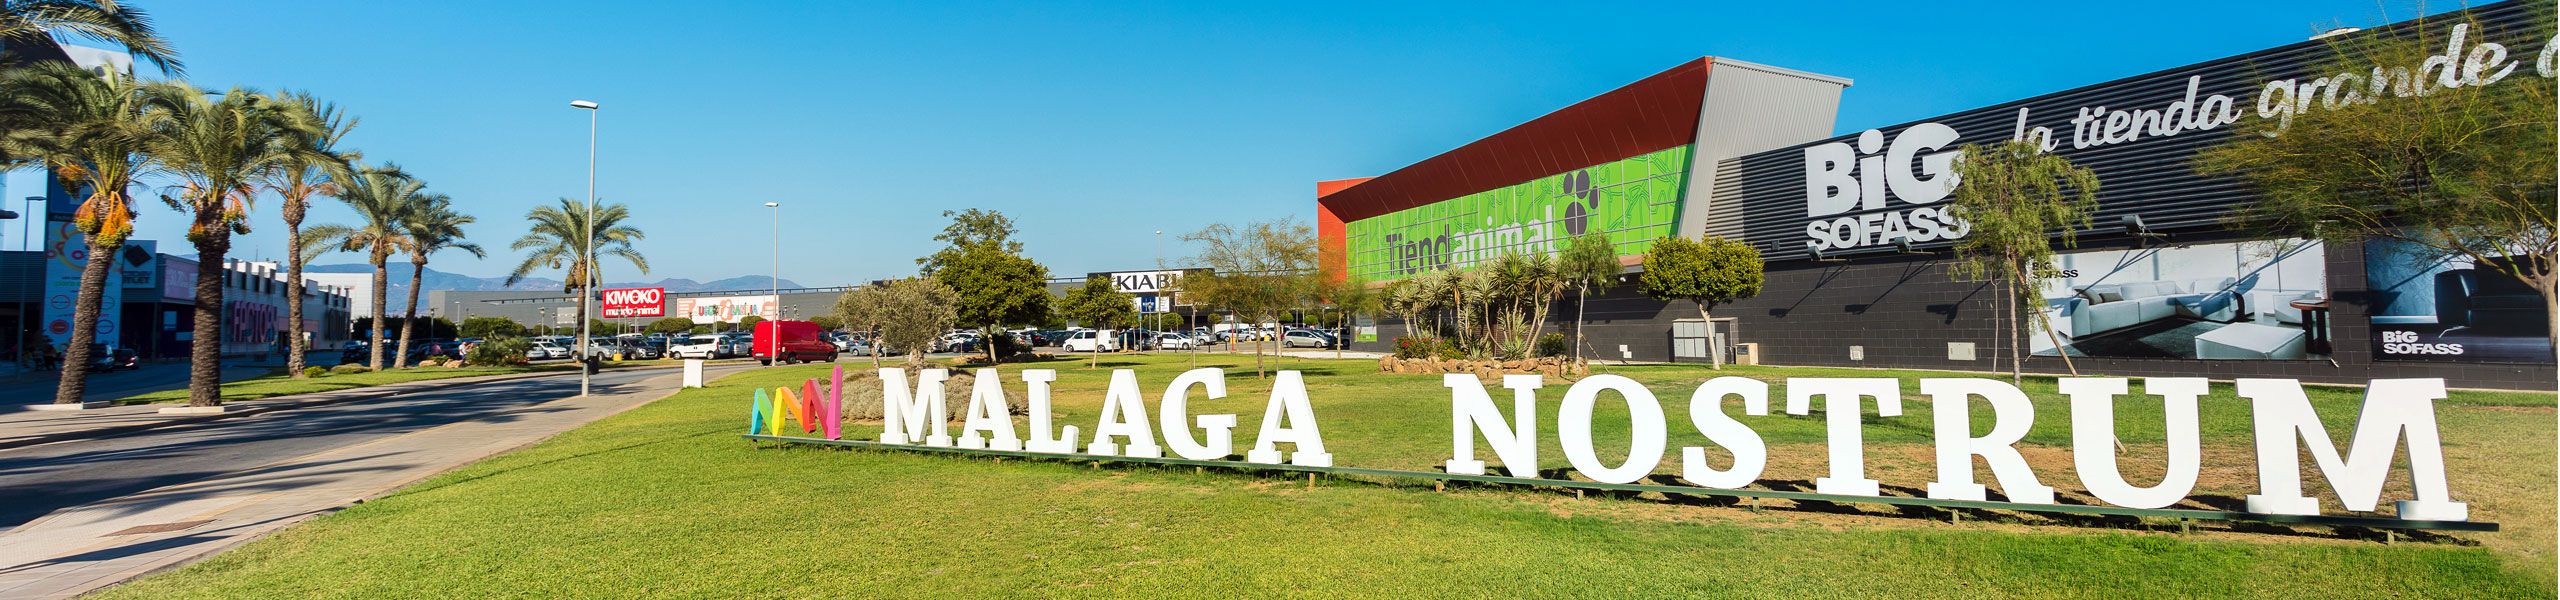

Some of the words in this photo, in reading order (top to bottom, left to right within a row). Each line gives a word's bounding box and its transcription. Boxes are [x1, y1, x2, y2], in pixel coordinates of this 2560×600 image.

[2013, 107, 2060, 157] la
[2070, 75, 2243, 150] tienda
[2257, 23, 2519, 138] grande
[1804, 122, 1965, 217] BiG
[1386, 204, 1557, 276] Tiendanimal
[1806, 206, 1971, 251] SOFASS
[605, 288, 661, 305] KIWOKO
[605, 305, 633, 316] mudo
[2382, 330, 2418, 343] BiG
[2383, 343, 2464, 355] SOFASS
[879, 366, 1333, 469] MALAGA
[1443, 372, 2468, 522] NOSTRUM
